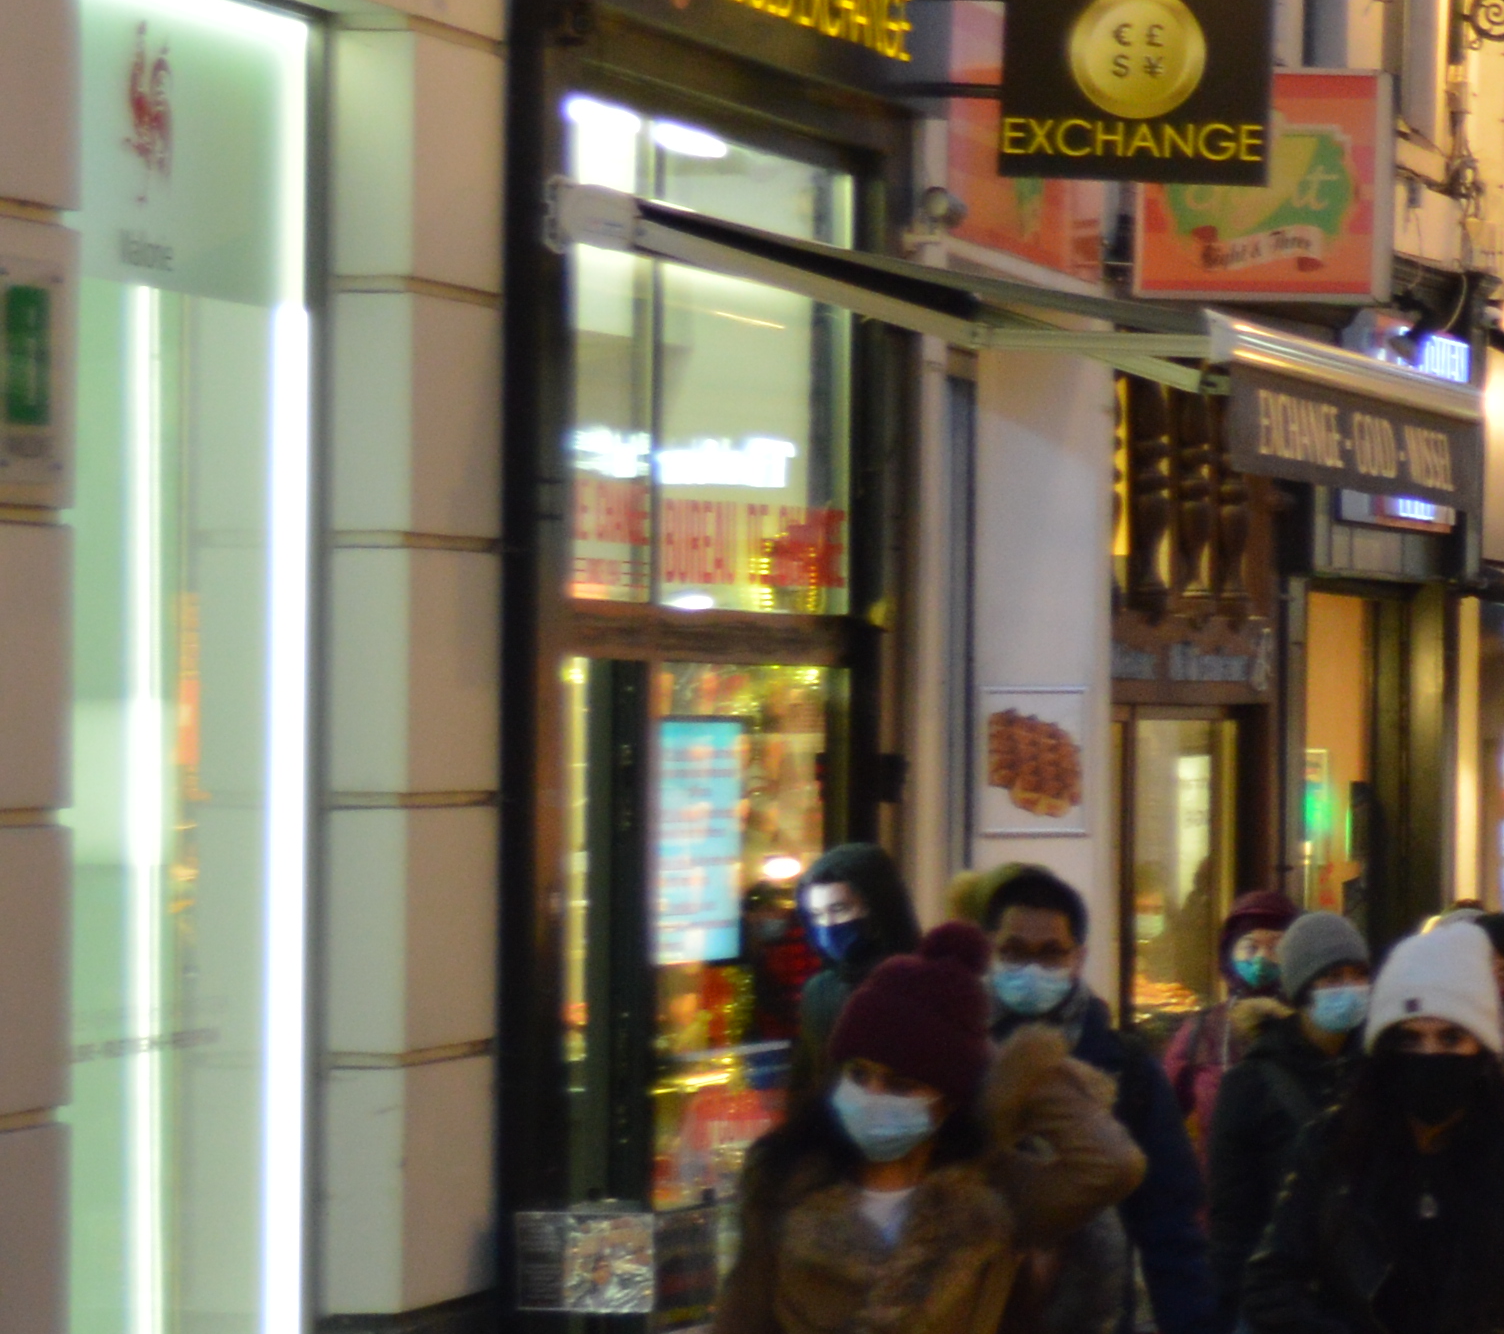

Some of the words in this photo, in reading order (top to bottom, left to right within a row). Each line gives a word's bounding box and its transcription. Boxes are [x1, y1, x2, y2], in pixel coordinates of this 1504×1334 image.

[1003, 117, 1264, 161] EXCHANGE
[1258, 389, 1345, 469] EXCHANGE
[1353, 411, 1398, 479] GOLD
